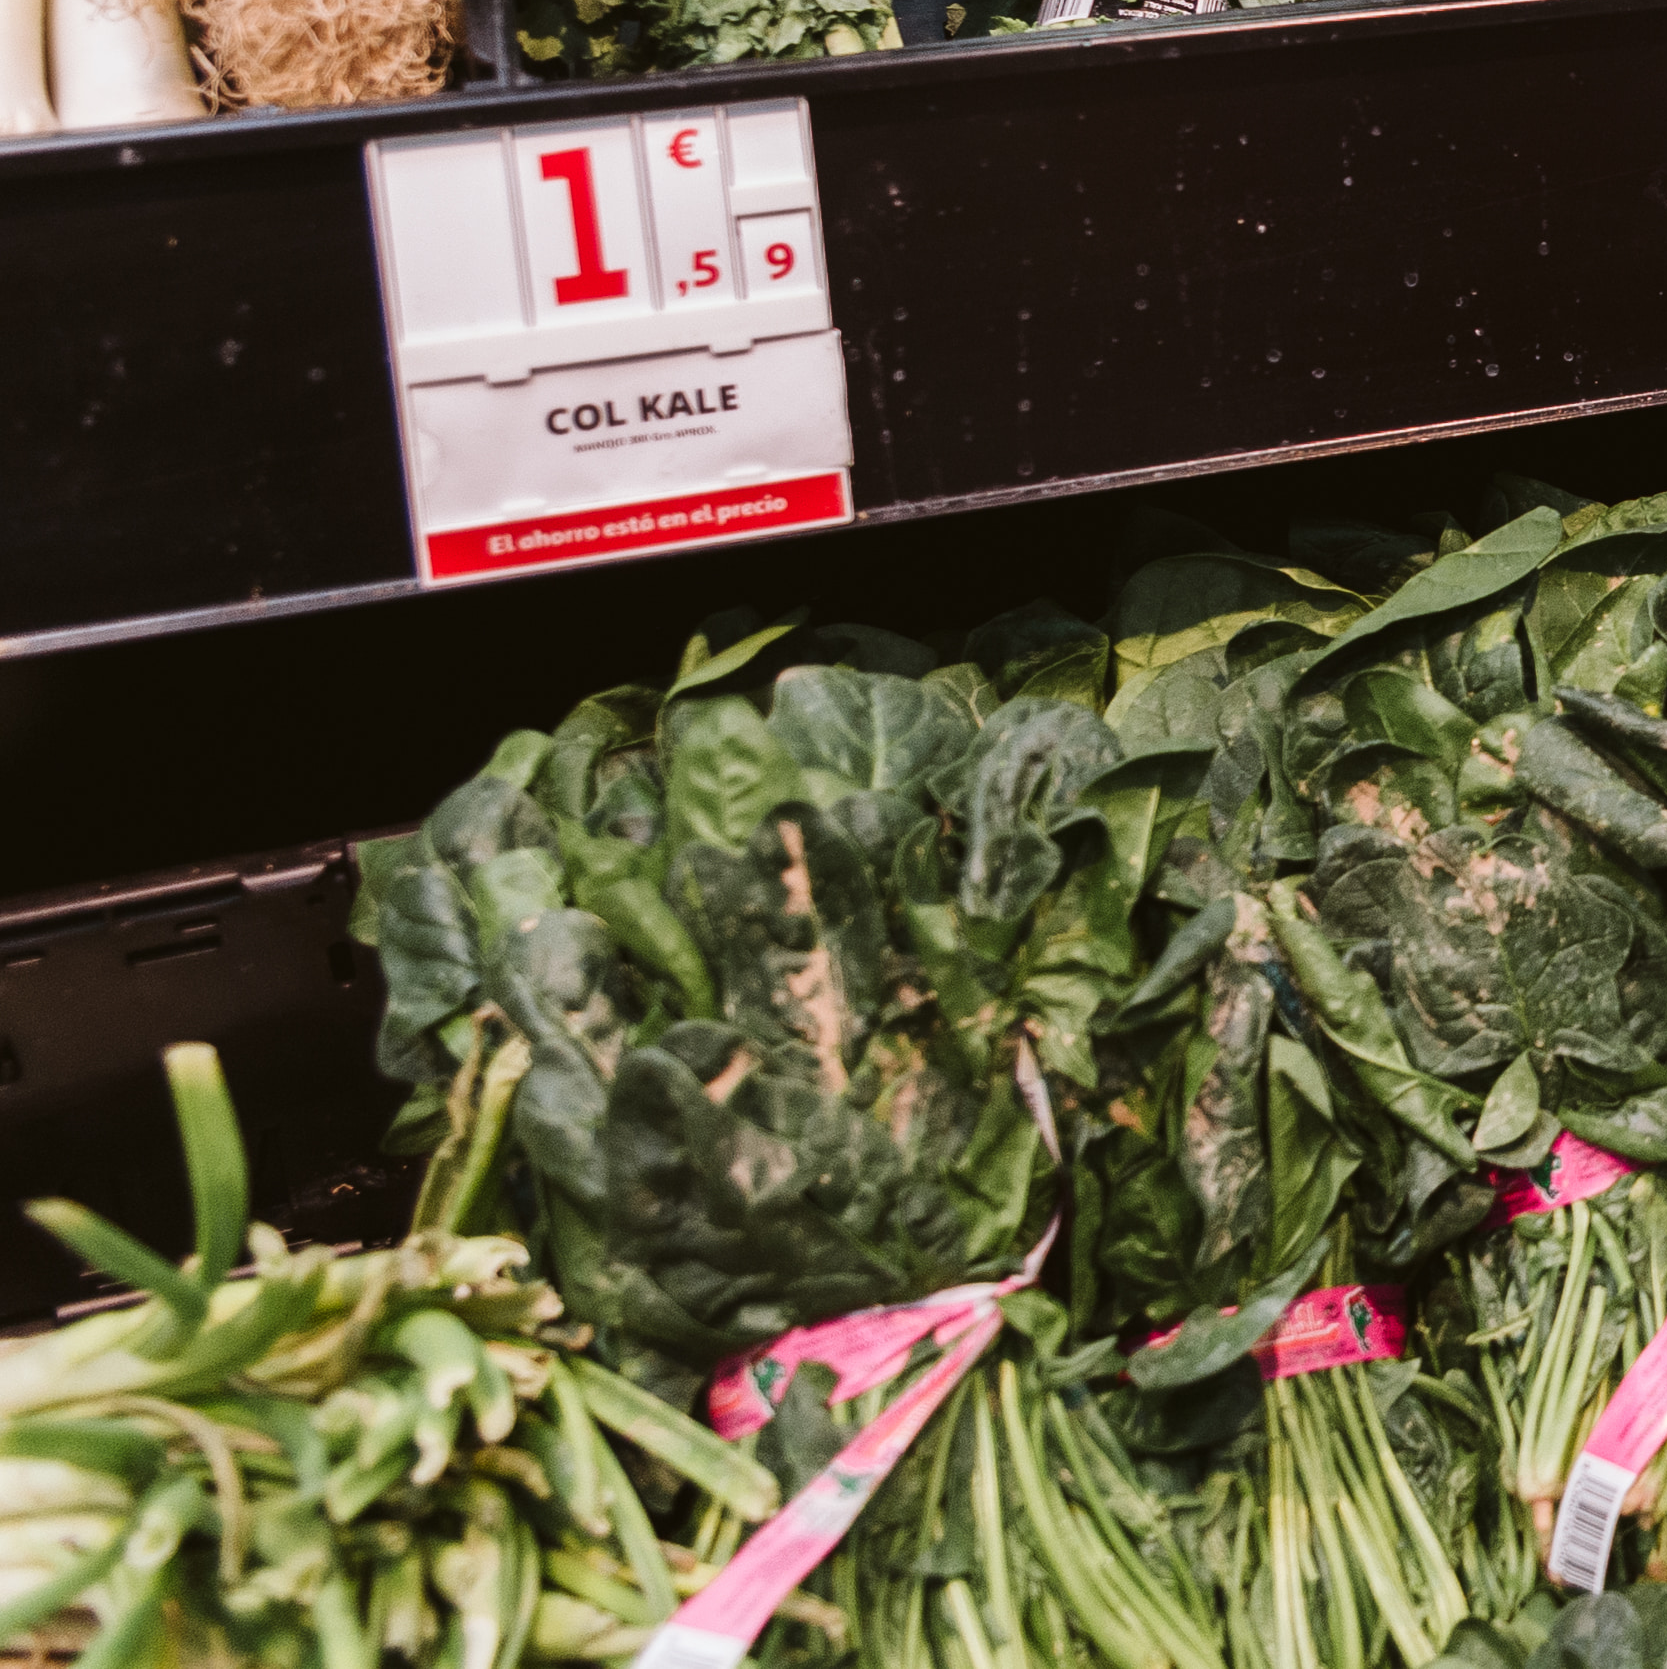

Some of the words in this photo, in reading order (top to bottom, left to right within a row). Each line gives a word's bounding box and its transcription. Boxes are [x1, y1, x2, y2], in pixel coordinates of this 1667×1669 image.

[539, 147, 629, 306] 1
[667, 129, 702, 168] €
[546, 400, 628, 435] COL
[640, 384, 739, 422] KALE
[487, 534, 514, 555] El
[518, 525, 600, 550] ahorro
[602, 513, 655, 537] está
[658, 511, 688, 529] en
[691, 504, 714, 524] el
[716, 494, 788, 525] precio
